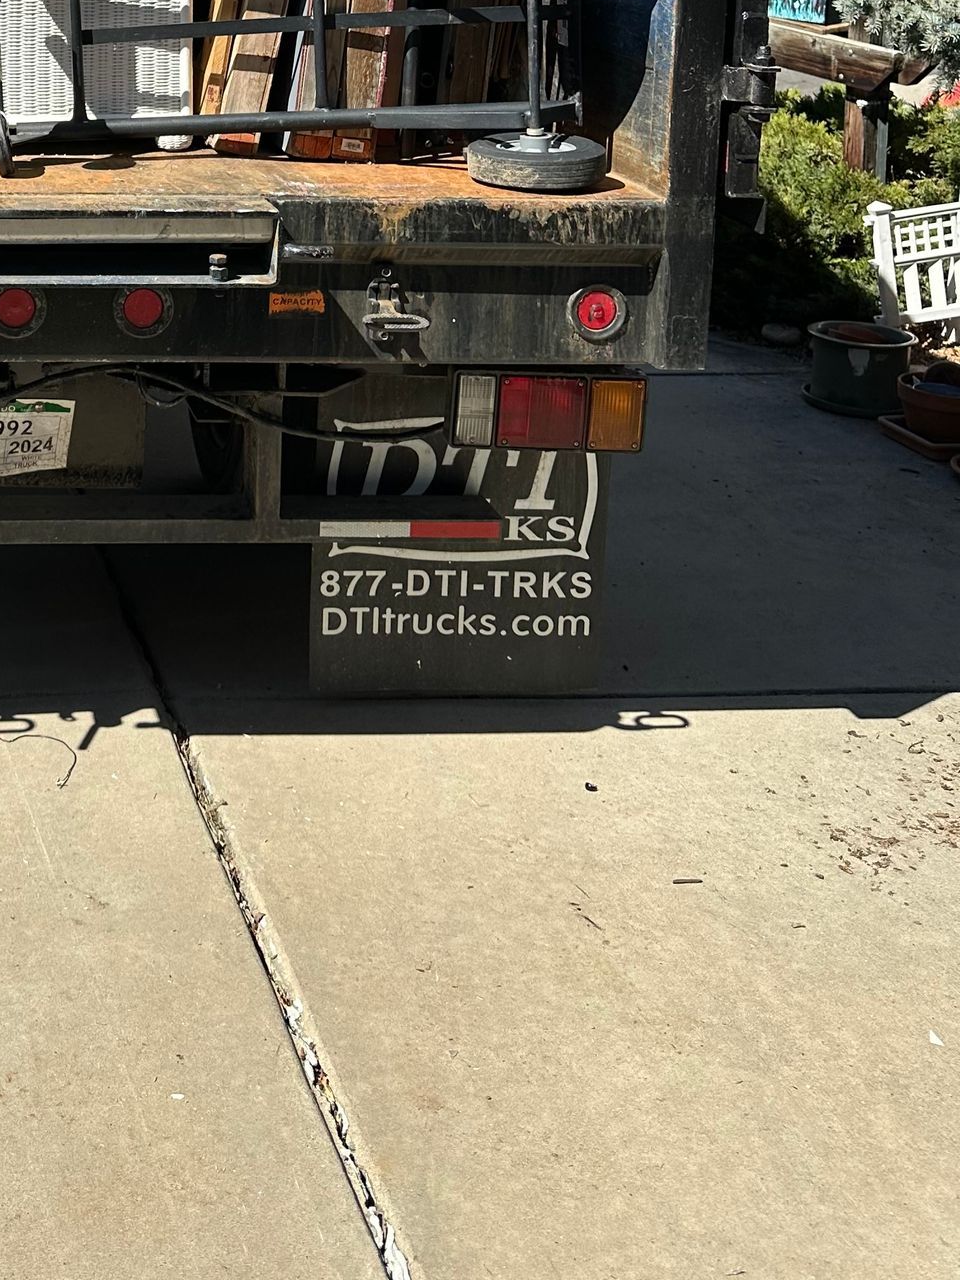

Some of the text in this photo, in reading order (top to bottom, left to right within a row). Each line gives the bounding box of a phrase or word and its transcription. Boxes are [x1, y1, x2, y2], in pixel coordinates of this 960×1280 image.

[272, 298, 322, 306] CAPACITY
[8, 436, 54, 456] 2024
[320, 570, 592, 599] 877-DTI-TRKS
[321, 605, 591, 636] DTItrucks.com
